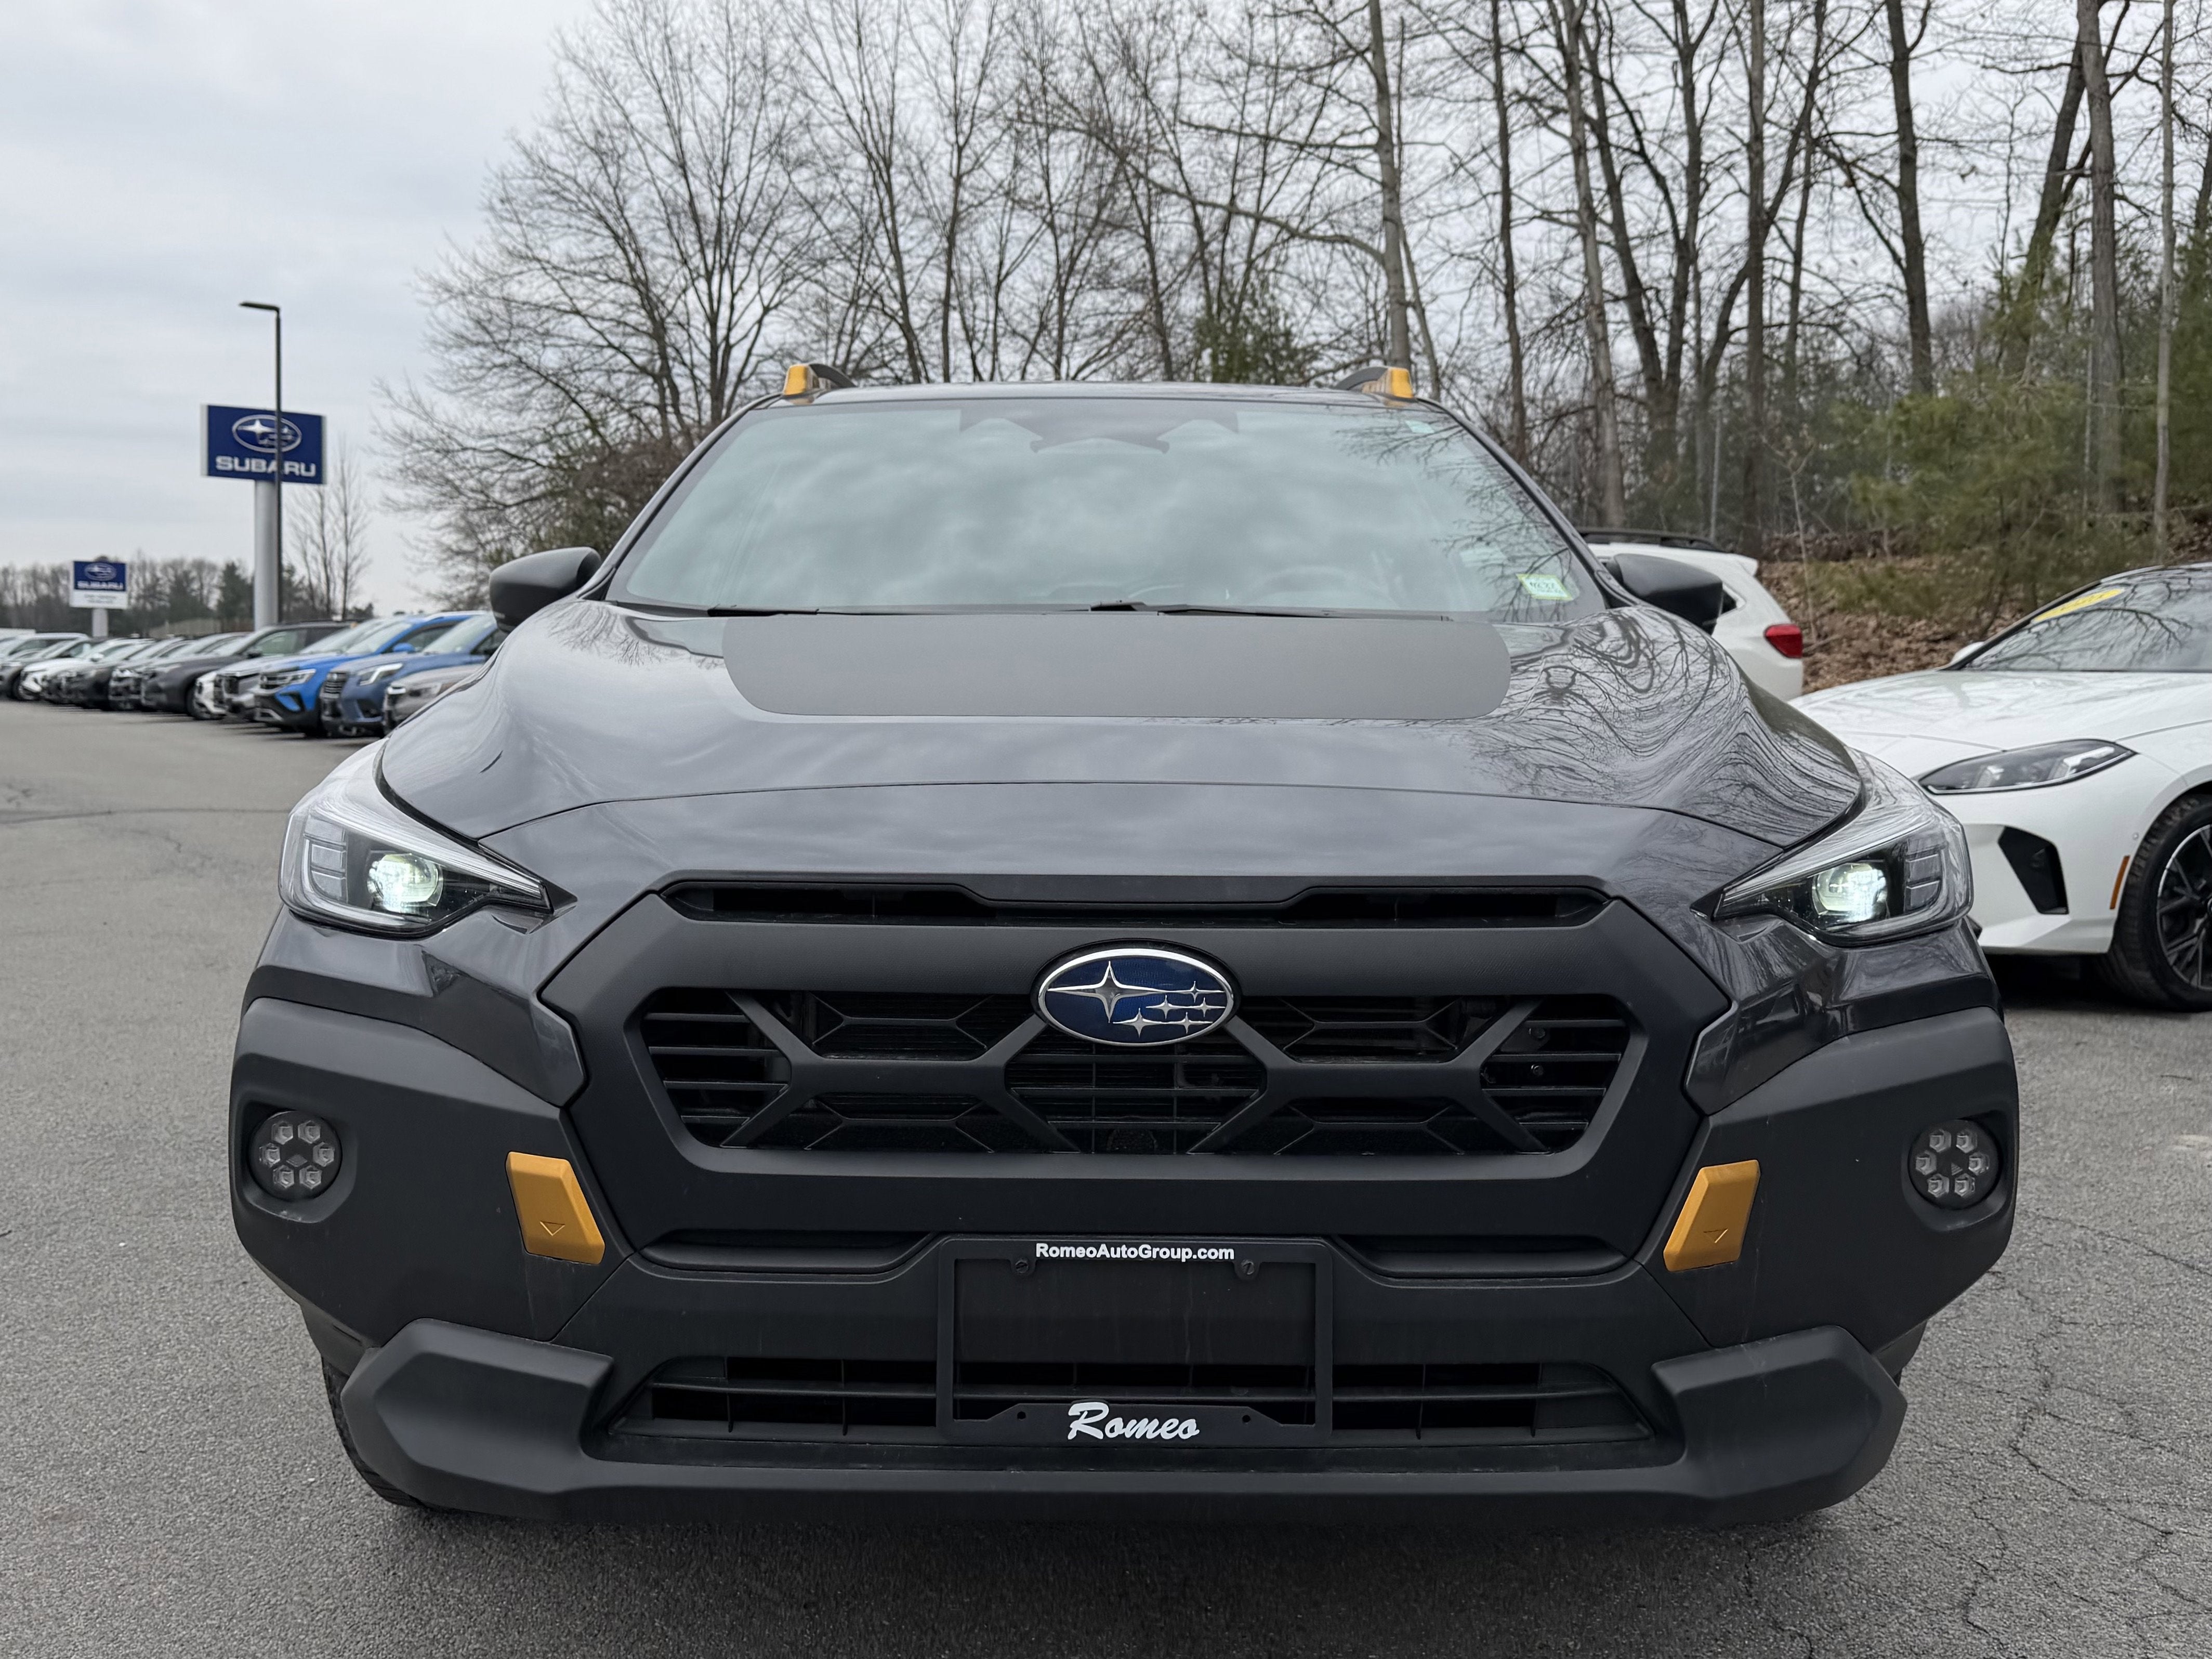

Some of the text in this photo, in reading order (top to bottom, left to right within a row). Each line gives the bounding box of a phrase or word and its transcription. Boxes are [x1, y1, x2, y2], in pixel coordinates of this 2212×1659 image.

[215, 455, 316, 477] SUBARU
[1036, 1243, 1234, 1262] RomeoAutoGroup.com
[1067, 1402, 1200, 1440] Romeo
